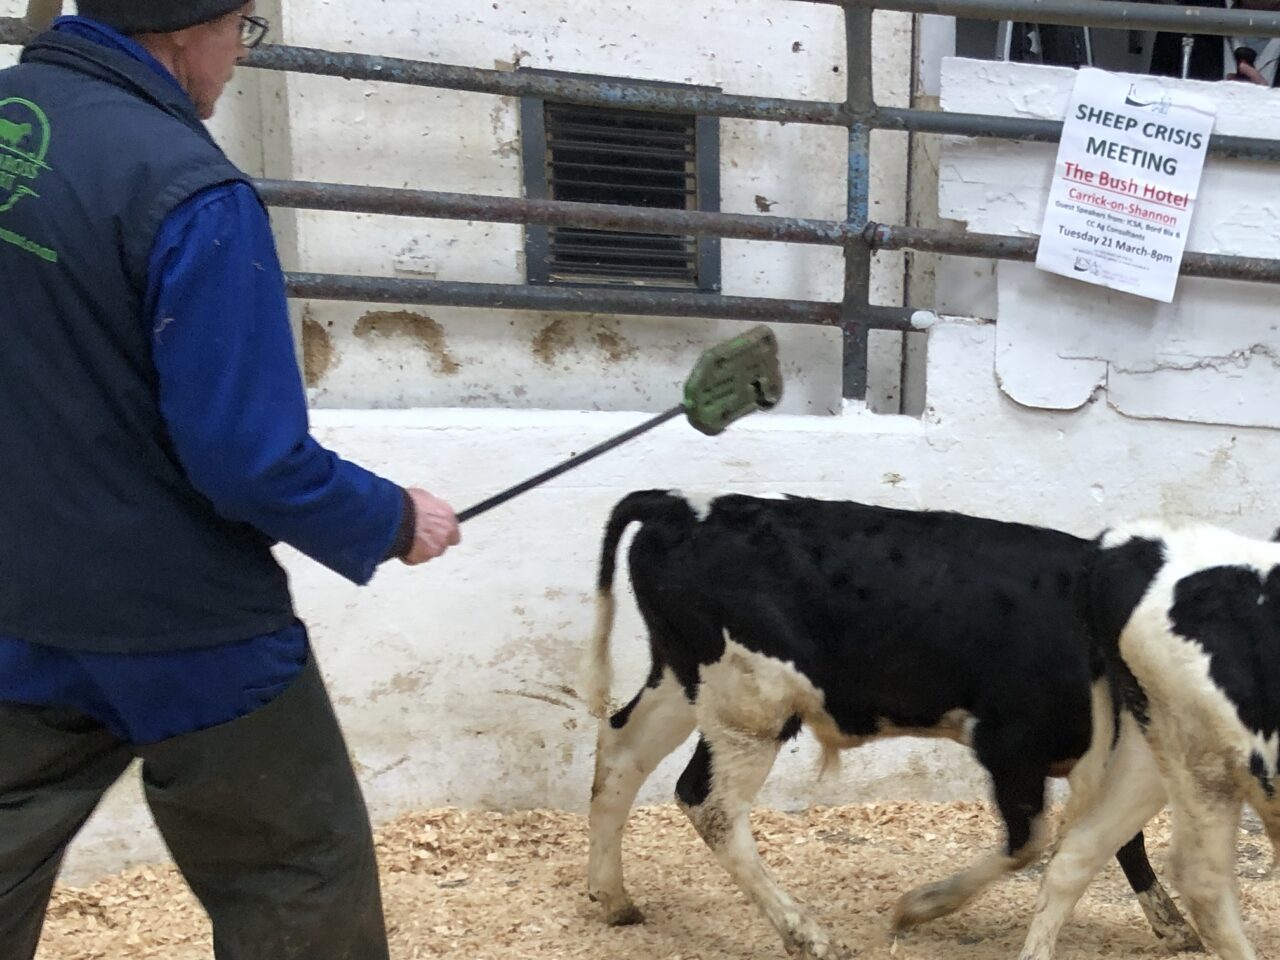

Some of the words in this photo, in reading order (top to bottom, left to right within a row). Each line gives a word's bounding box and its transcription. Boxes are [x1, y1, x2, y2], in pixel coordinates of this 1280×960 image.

[1075, 103, 1138, 132] SHEEP
[1142, 122, 1203, 149] CRISIS
[1086, 136, 1178, 176] MEETING
[1062, 162, 1094, 184] The
[1098, 171, 1138, 194] Bush
[1143, 184, 1190, 209] Hotel
[1055, 200, 1074, 211] Guest
[1076, 206, 1106, 219] Speakers
[1068, 188, 1177, 225] Carrick-on-Shannon
[1058, 225, 1099, 244] Tuesday
[1102, 236, 1112, 247] 21
[1115, 240, 1173, 263] March-8pm
[1086, 220, 1094, 228] CC
[1106, 226, 1145, 240] Consultants
